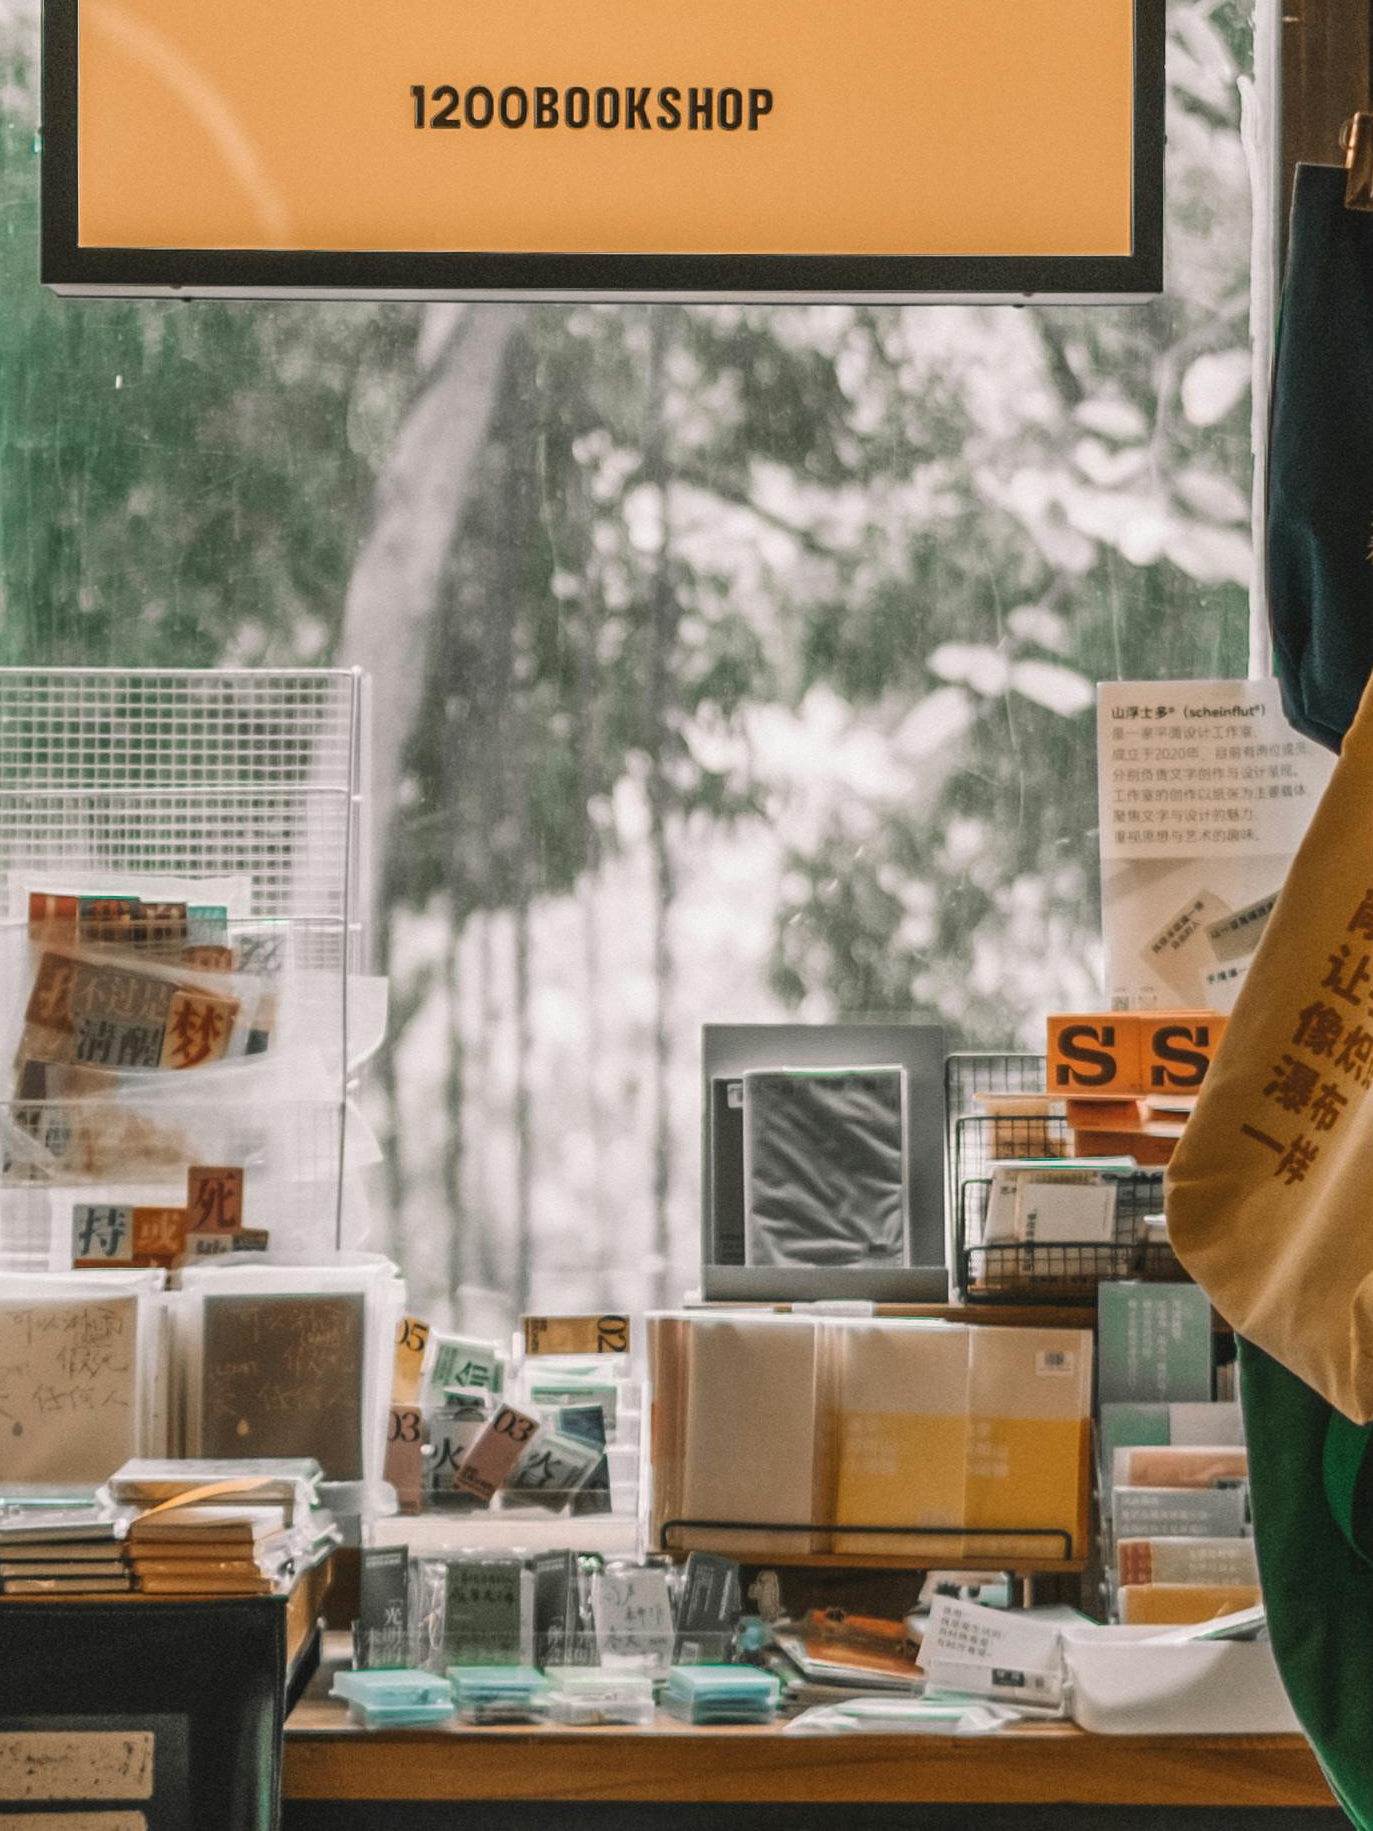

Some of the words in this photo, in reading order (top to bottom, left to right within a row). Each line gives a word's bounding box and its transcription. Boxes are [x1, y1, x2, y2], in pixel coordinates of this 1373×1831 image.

[409, 83, 775, 133] 1200BOOKSHOP
[169, 998, 224, 1071] 梦
[1055, 1023, 1118, 1087] S
[1150, 1024, 1212, 1087] S
[1238, 1122, 1320, 1186] 一样
[191, 1172, 238, 1229] 死
[78, 1207, 128, 1257] 持
[492, 1408, 535, 1443] 03
